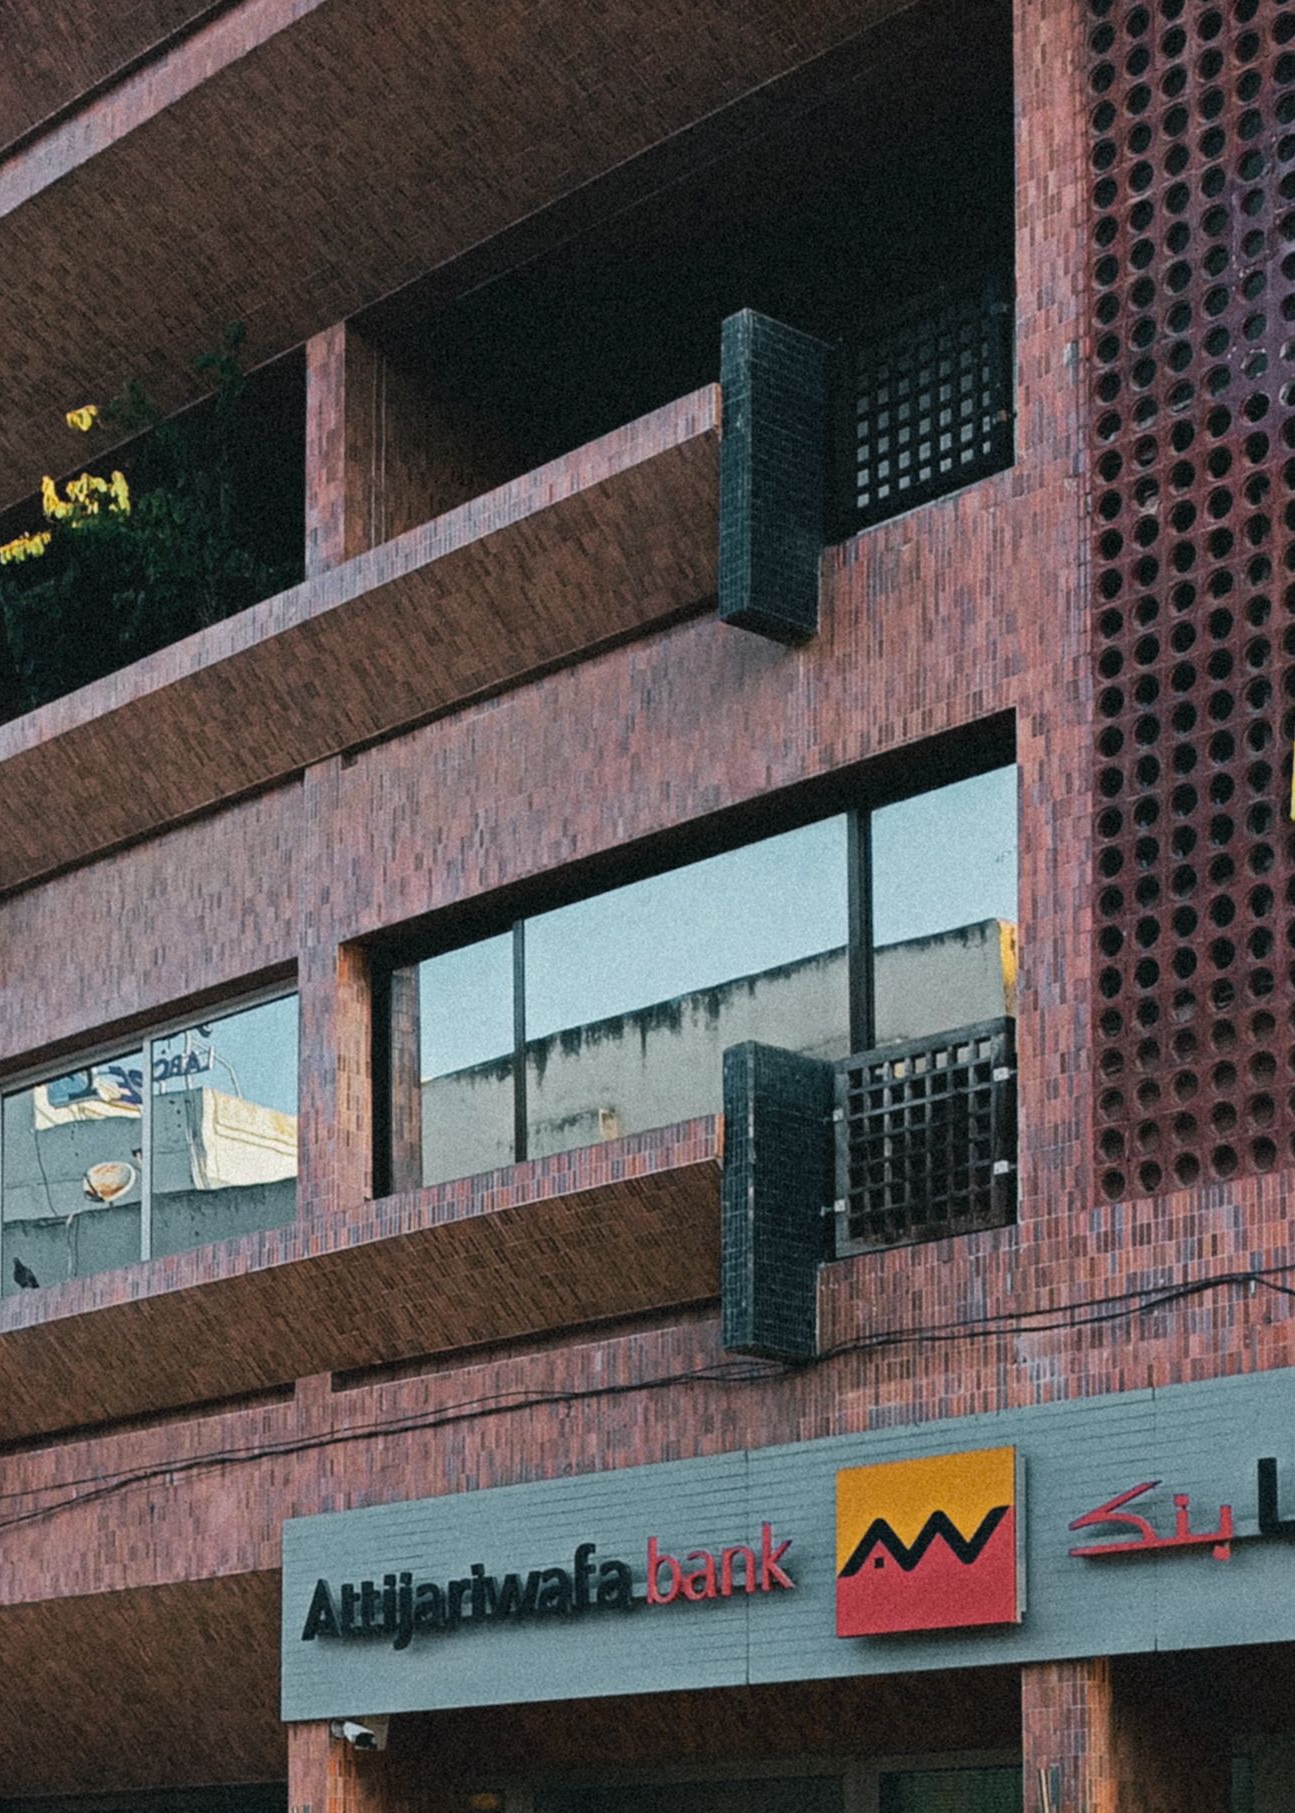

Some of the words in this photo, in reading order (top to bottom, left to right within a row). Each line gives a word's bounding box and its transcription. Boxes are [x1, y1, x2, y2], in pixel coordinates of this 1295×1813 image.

[1068, 1480, 1233, 1562] بنك
[301, 1542, 633, 1650] Attijariwafa
[647, 1521, 795, 1604] bank
